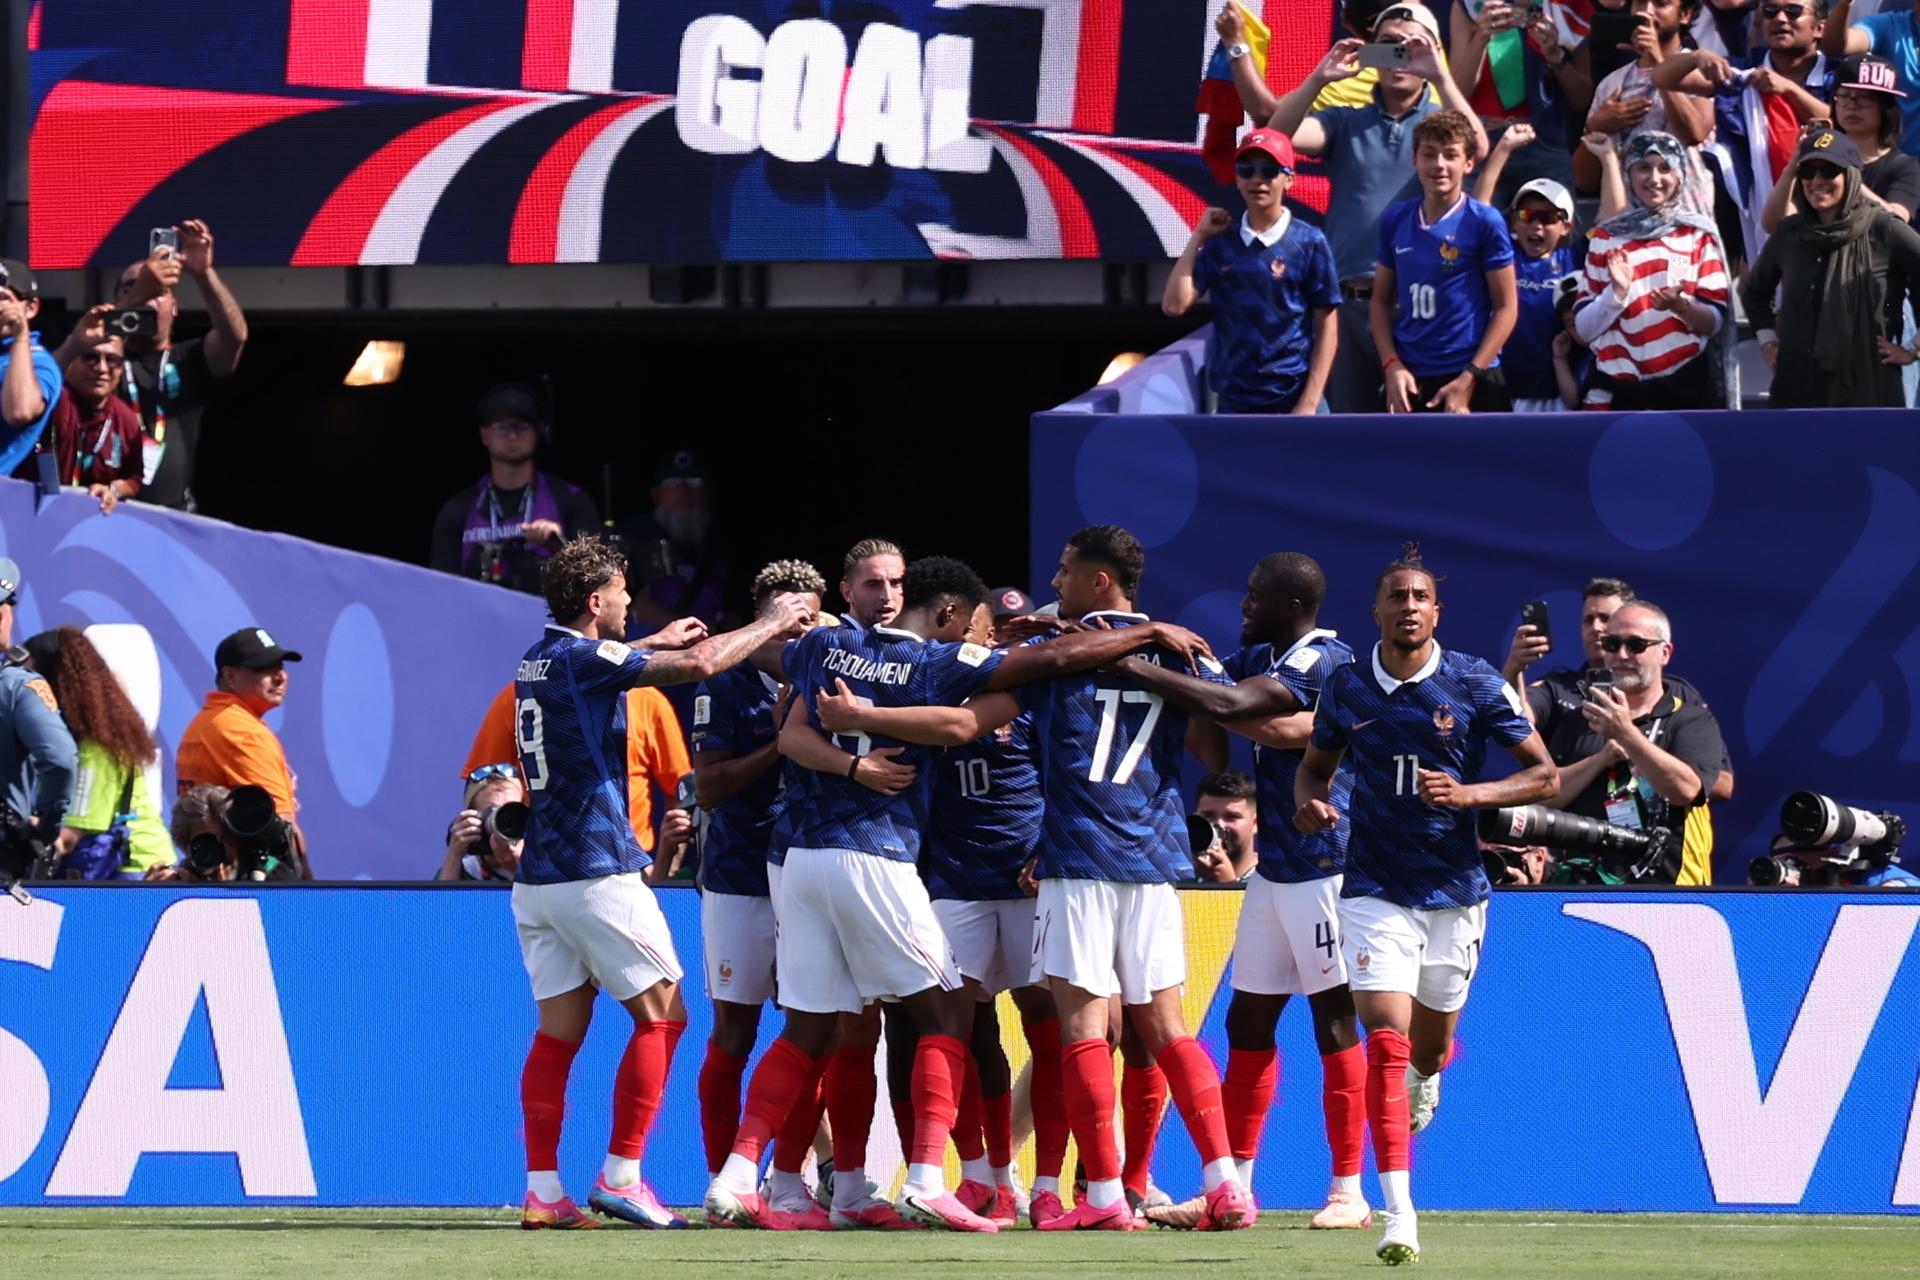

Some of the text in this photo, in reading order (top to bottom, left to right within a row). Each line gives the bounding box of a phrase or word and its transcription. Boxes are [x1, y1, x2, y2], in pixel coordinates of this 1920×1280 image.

[675, 14, 992, 173] GOAL
[1858, 62, 1896, 90] RUN
[1409, 283, 1436, 320] 10
[1516, 278, 1557, 291] RANC
[822, 648, 912, 685] TCHOUAMENI
[1088, 688, 1164, 784] 17
[955, 758, 990, 797] 10
[1393, 754, 1419, 796] 11
[1315, 921, 1335, 959] 4
[0, 896, 318, 1197] A
[1562, 902, 1920, 1205] V
